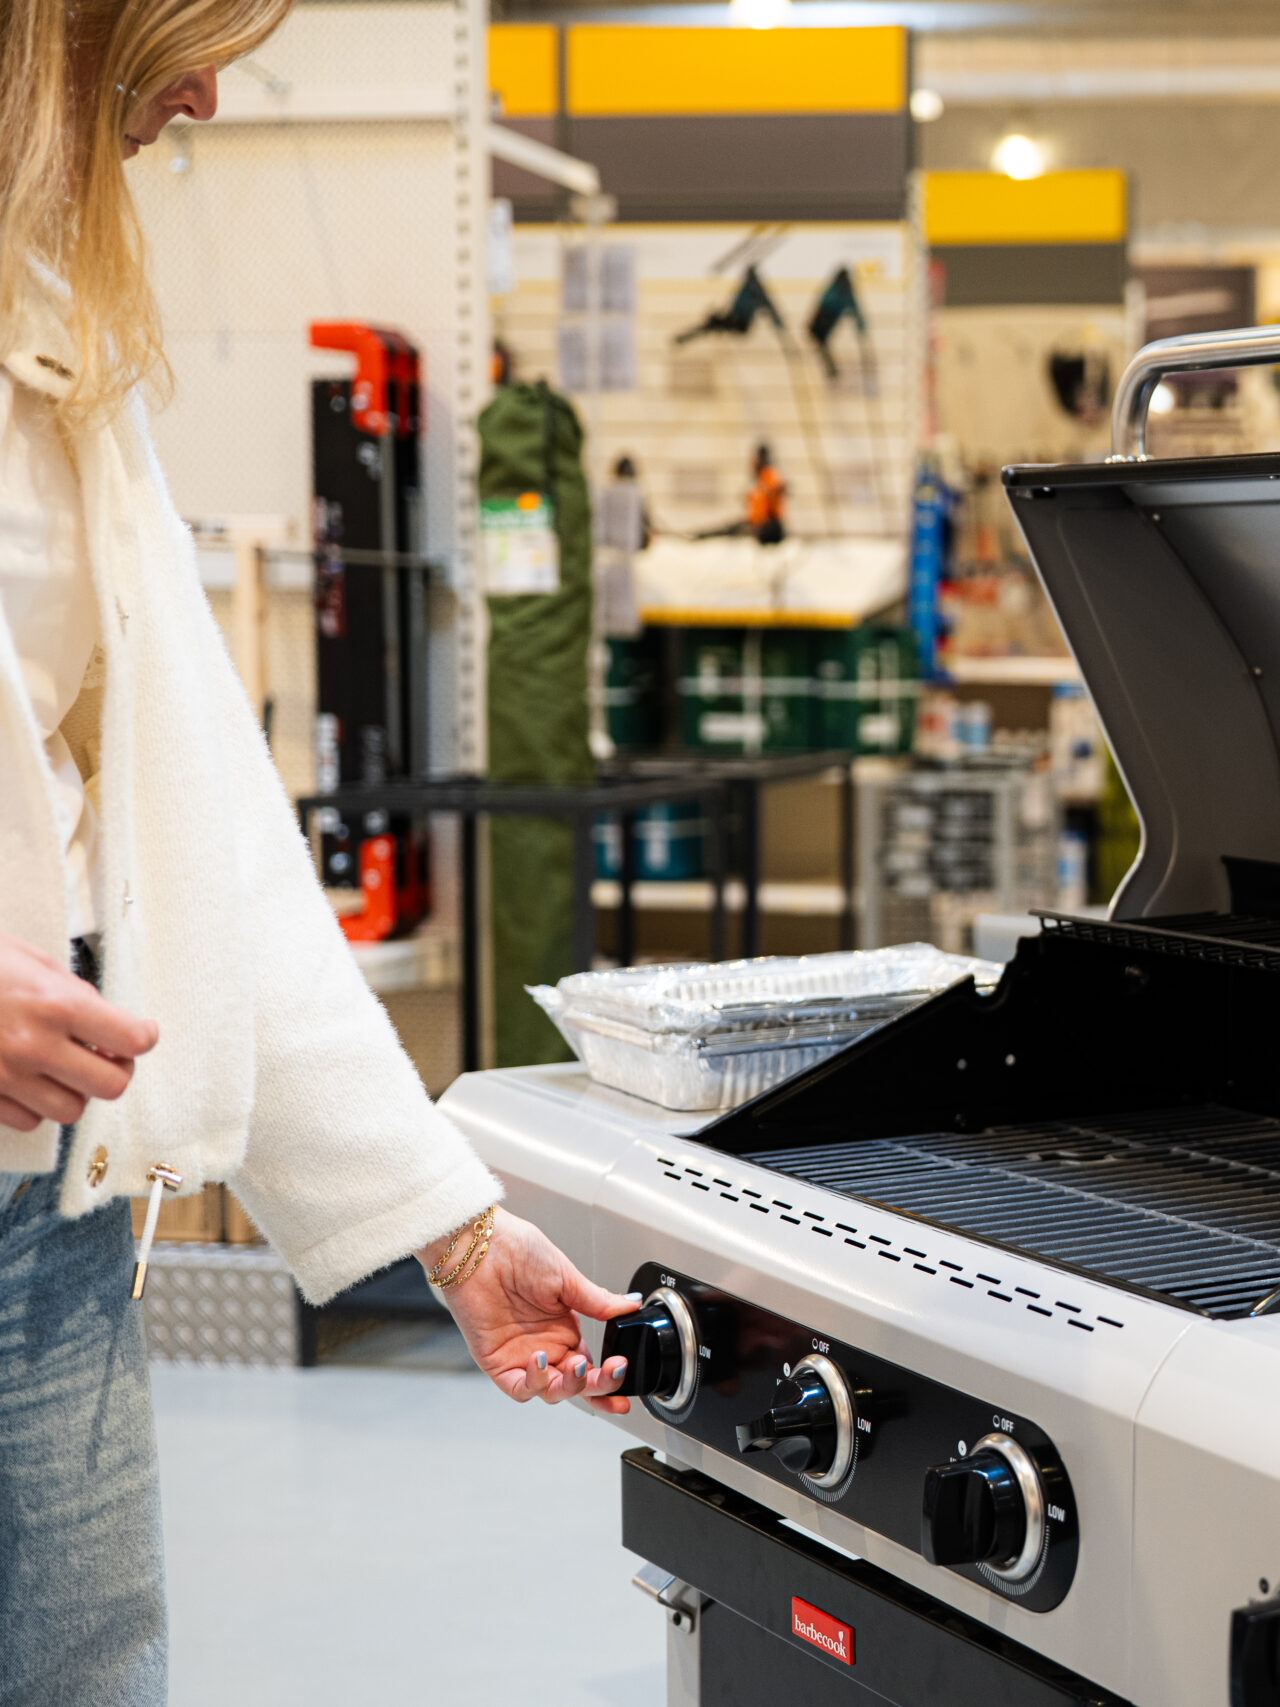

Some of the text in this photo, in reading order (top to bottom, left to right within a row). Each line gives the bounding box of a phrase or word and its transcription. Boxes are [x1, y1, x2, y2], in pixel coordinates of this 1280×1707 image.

[666, 1276, 677, 1288] OFF
[699, 1344, 712, 1360] LOW
[818, 1340, 830, 1353] OFF
[857, 1416, 872, 1433] LOW
[1001, 1417, 1015, 1433] OFF
[1047, 1503, 1066, 1523] LOW
[794, 1613, 848, 1659] barbecook
